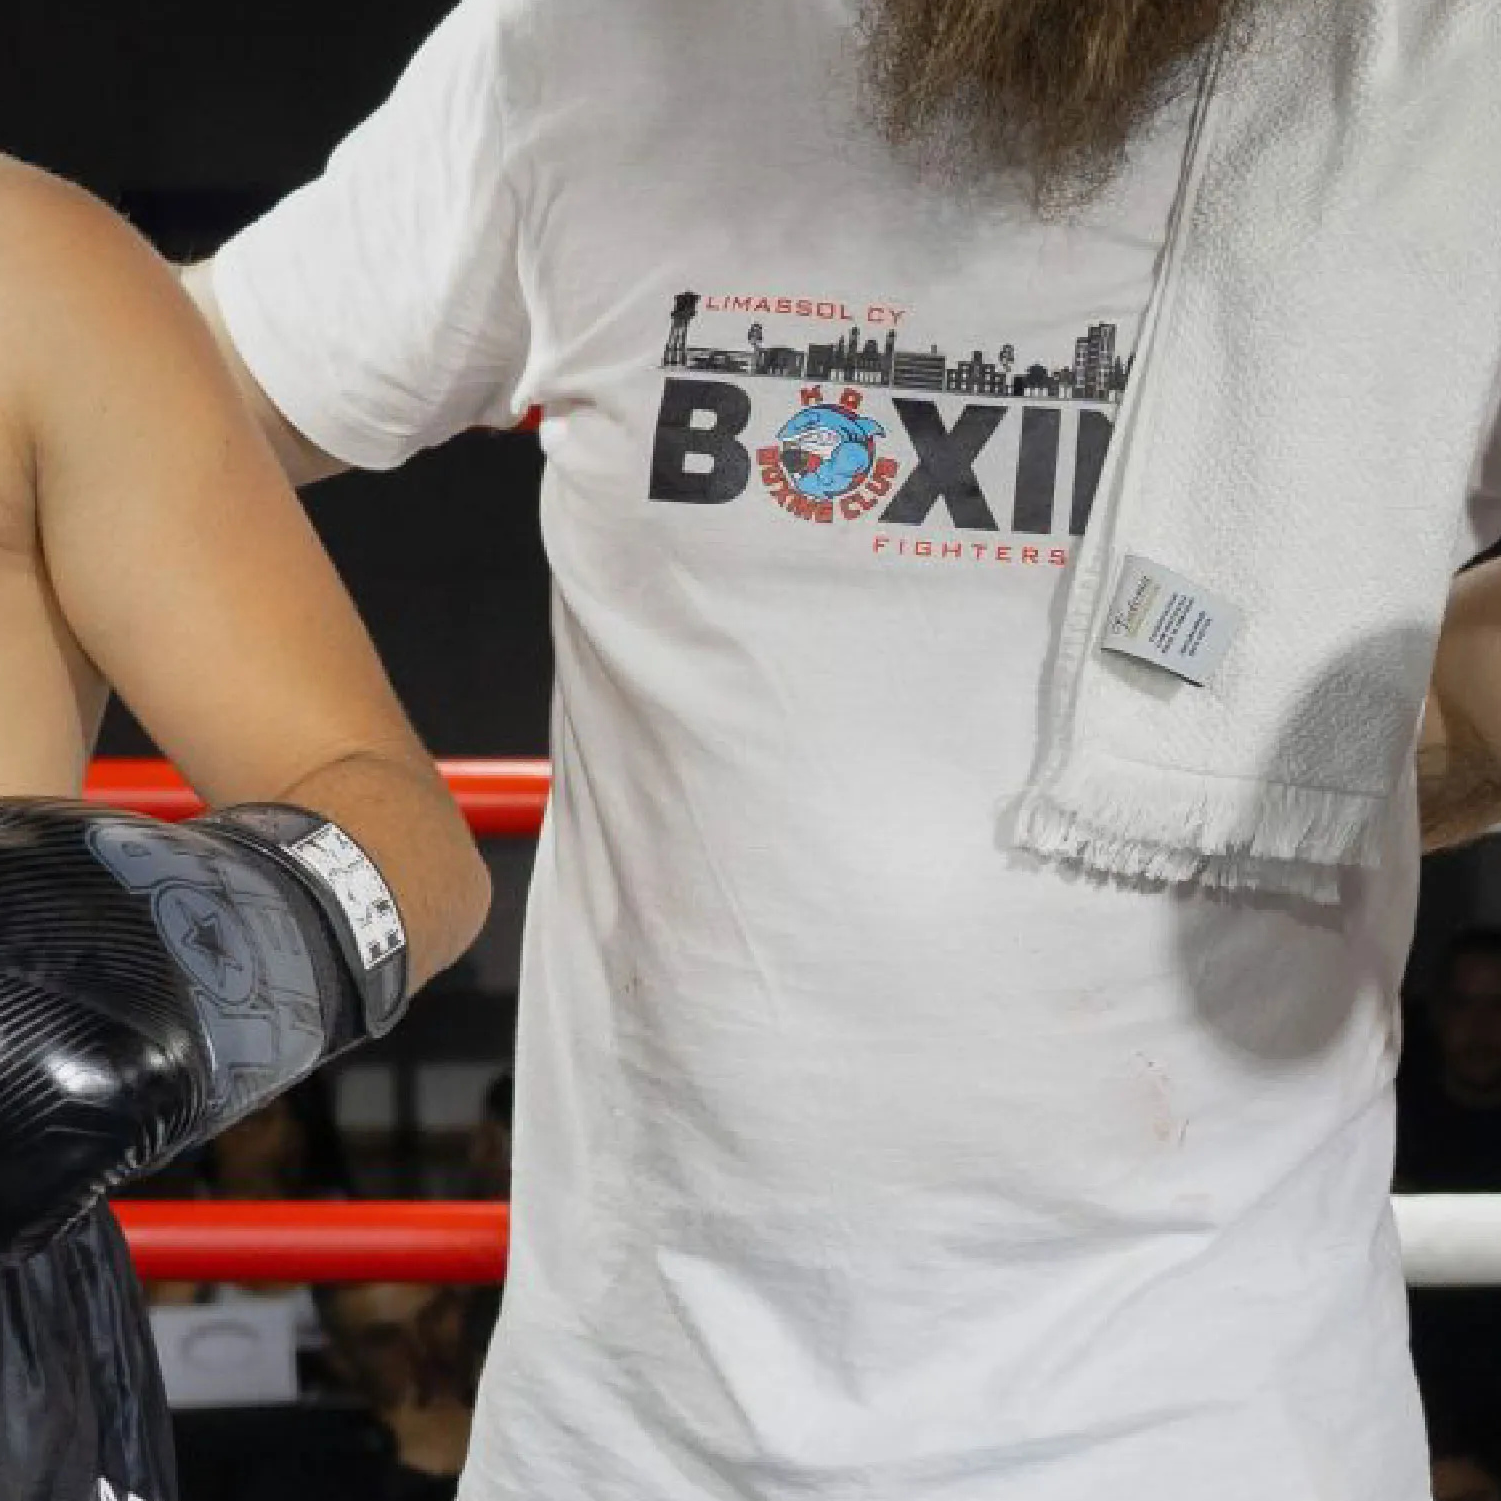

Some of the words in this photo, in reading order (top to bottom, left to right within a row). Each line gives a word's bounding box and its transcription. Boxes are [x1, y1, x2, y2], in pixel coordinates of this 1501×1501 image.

[706, 295, 853, 322] LIMASSOL
[868, 306, 905, 326] CY
[873, 538, 1069, 568] FIGHTERS
